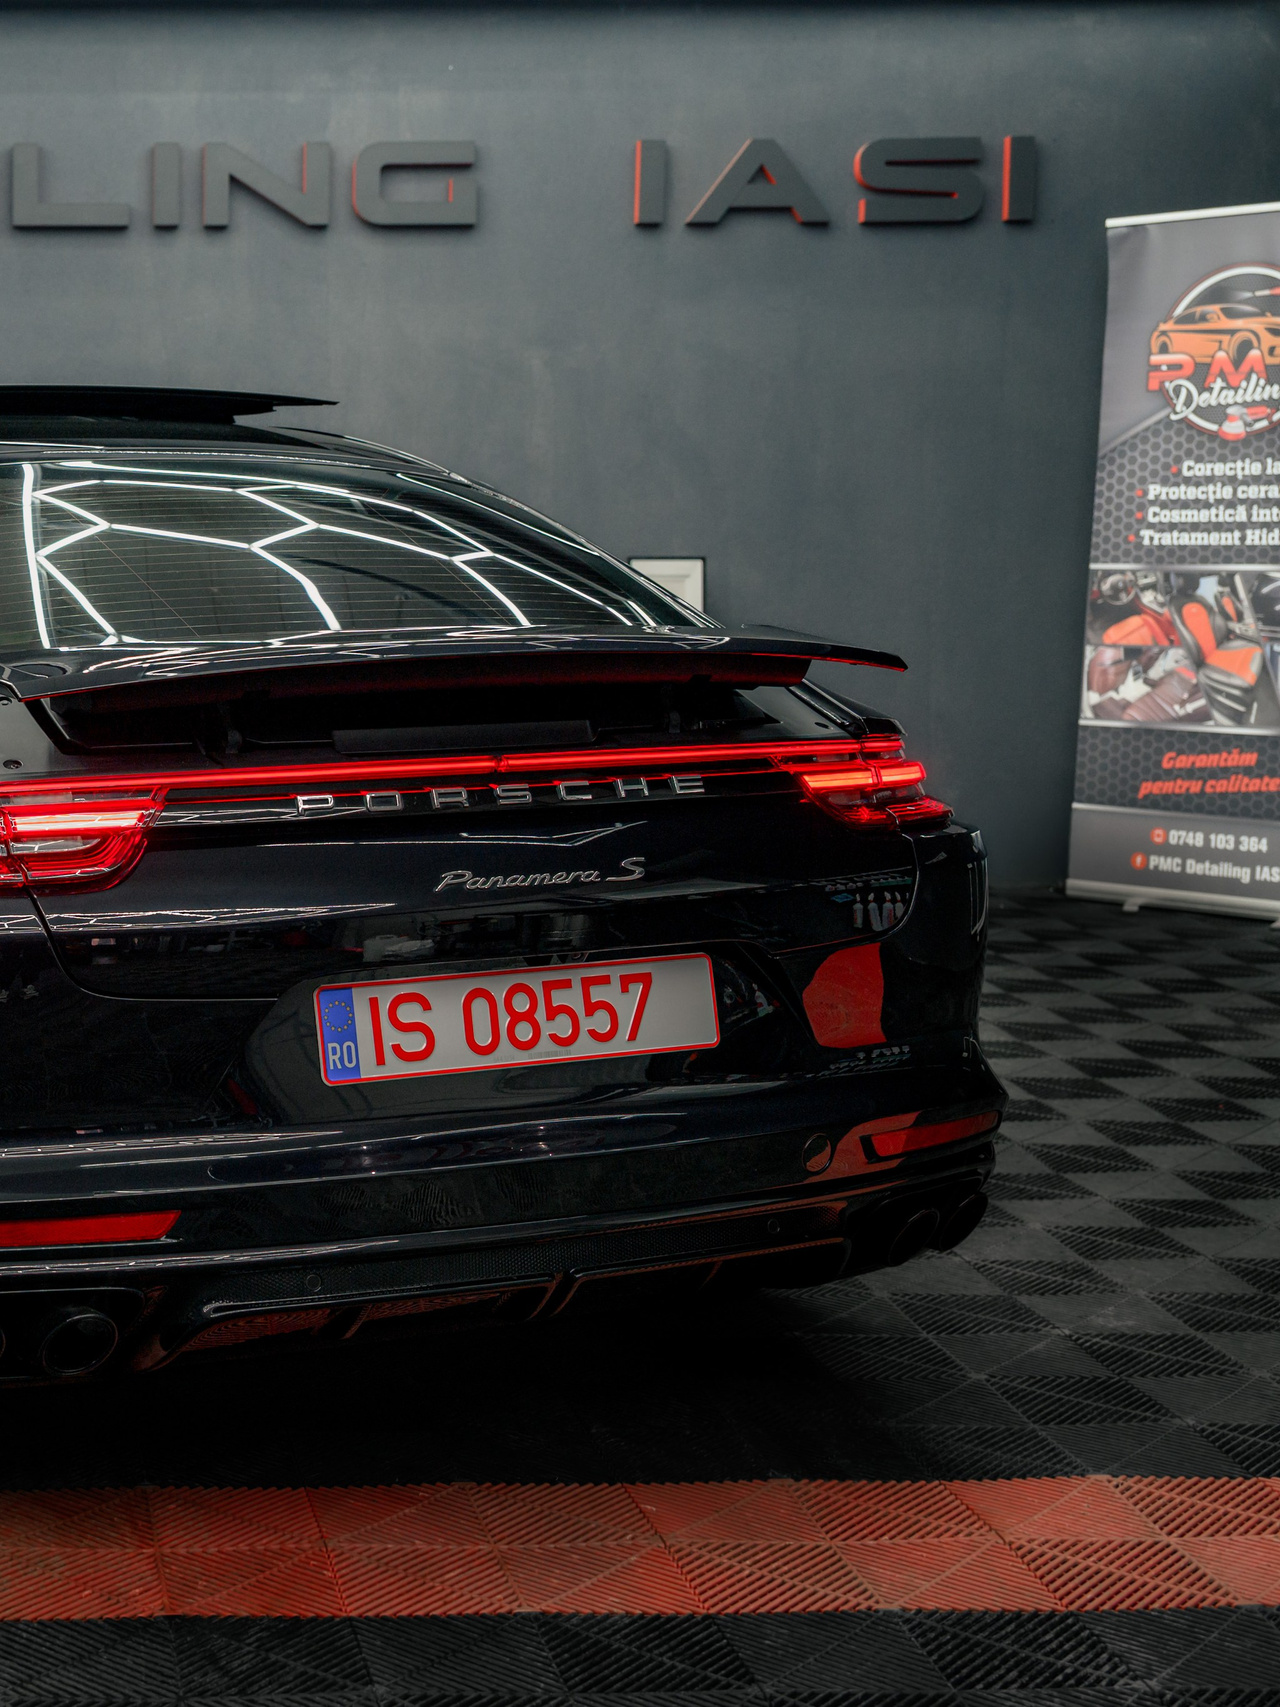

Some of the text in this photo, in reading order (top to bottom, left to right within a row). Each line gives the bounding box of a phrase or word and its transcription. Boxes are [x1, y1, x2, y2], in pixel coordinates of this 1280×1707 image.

[632, 135, 1040, 228] IASI
[1147, 505, 1247, 523] Cosmetică
[1139, 527, 1241, 546] Tratament
[1161, 748, 1258, 769] Garantăm
[296, 774, 706, 817] PORSCHE
[1138, 777, 1203, 799] pentru
[1168, 829, 1204, 848] 0748
[1209, 833, 1235, 850] 103
[434, 857, 645, 893] Panamera S
[1149, 854, 1182, 873] PMC
[1185, 858, 1251, 884] Detailing
[367, 972, 653, 1067] IS 08557
[328, 1040, 357, 1070] RO
